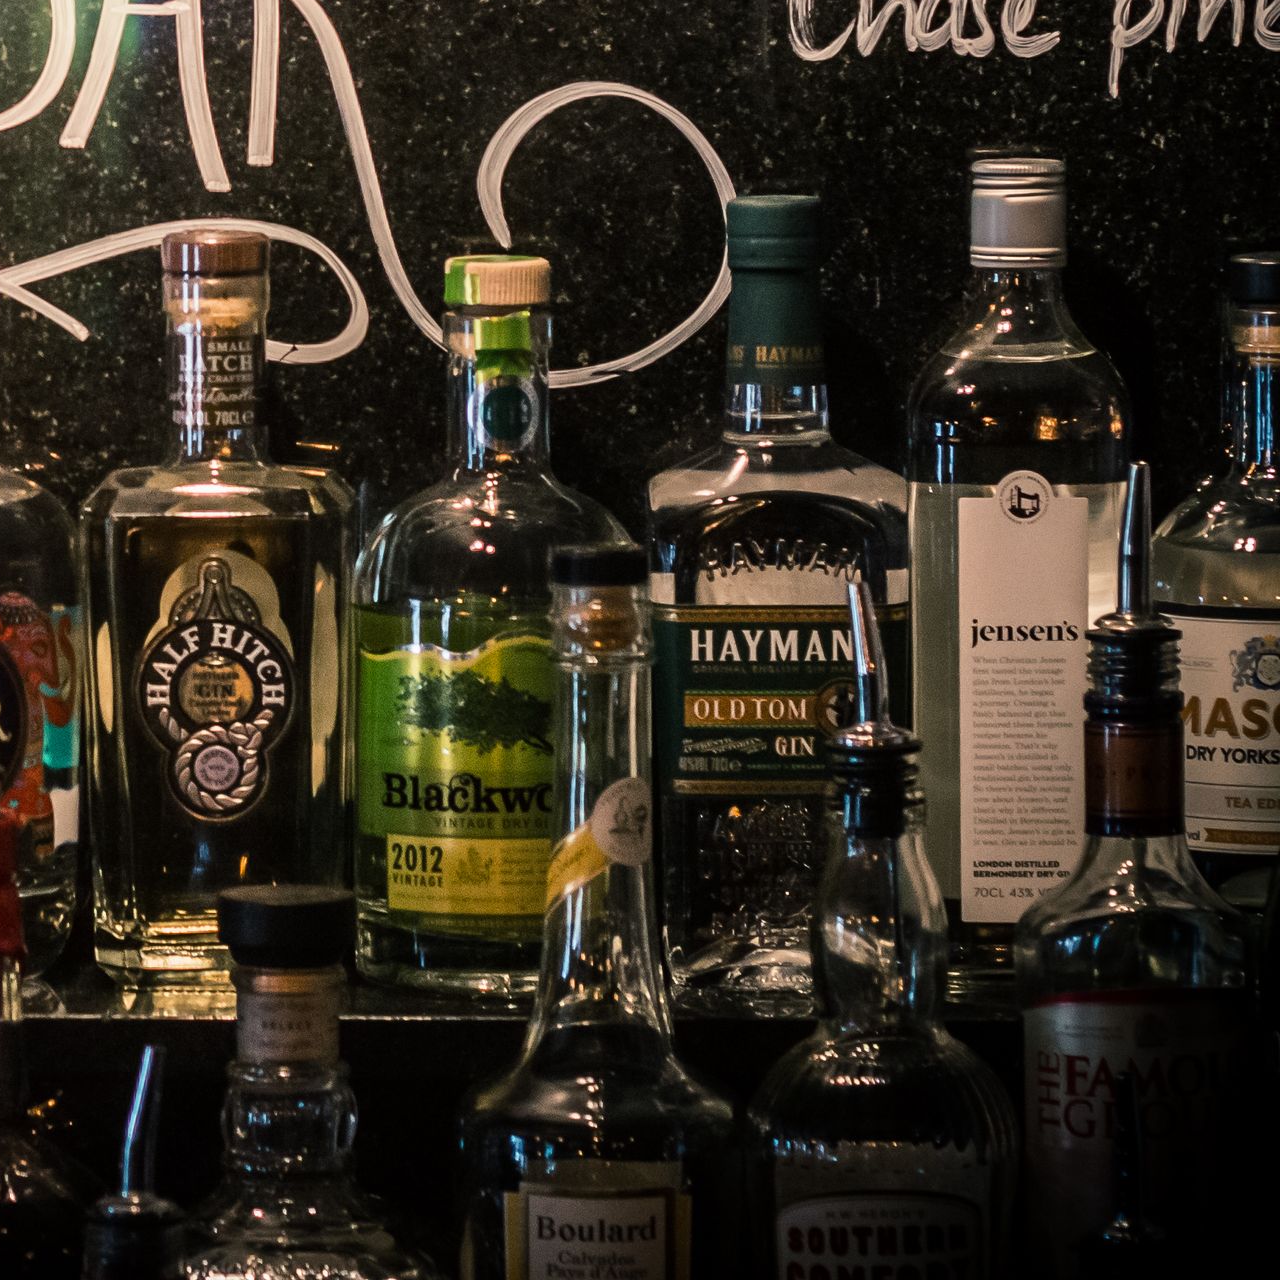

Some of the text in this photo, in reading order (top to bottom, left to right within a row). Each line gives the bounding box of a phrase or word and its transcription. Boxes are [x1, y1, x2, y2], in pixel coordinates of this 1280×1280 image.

[971, 618, 1079, 649] jensen's
[146, 622, 286, 708] HALF HITCH
[693, 697, 807, 721] OLD TOM
[774, 735, 817, 757] GIN
[391, 842, 444, 874] 2012
[973, 860, 1060, 868] LONDON DISTILLED
[391, 874, 444, 888] VINTAGE
[973, 870, 1035, 878] BERMONDSEY
[1037, 870, 1054, 878] DRY
[974, 887, 1005, 898] 70CL
[536, 1214, 657, 1243] Boulard
